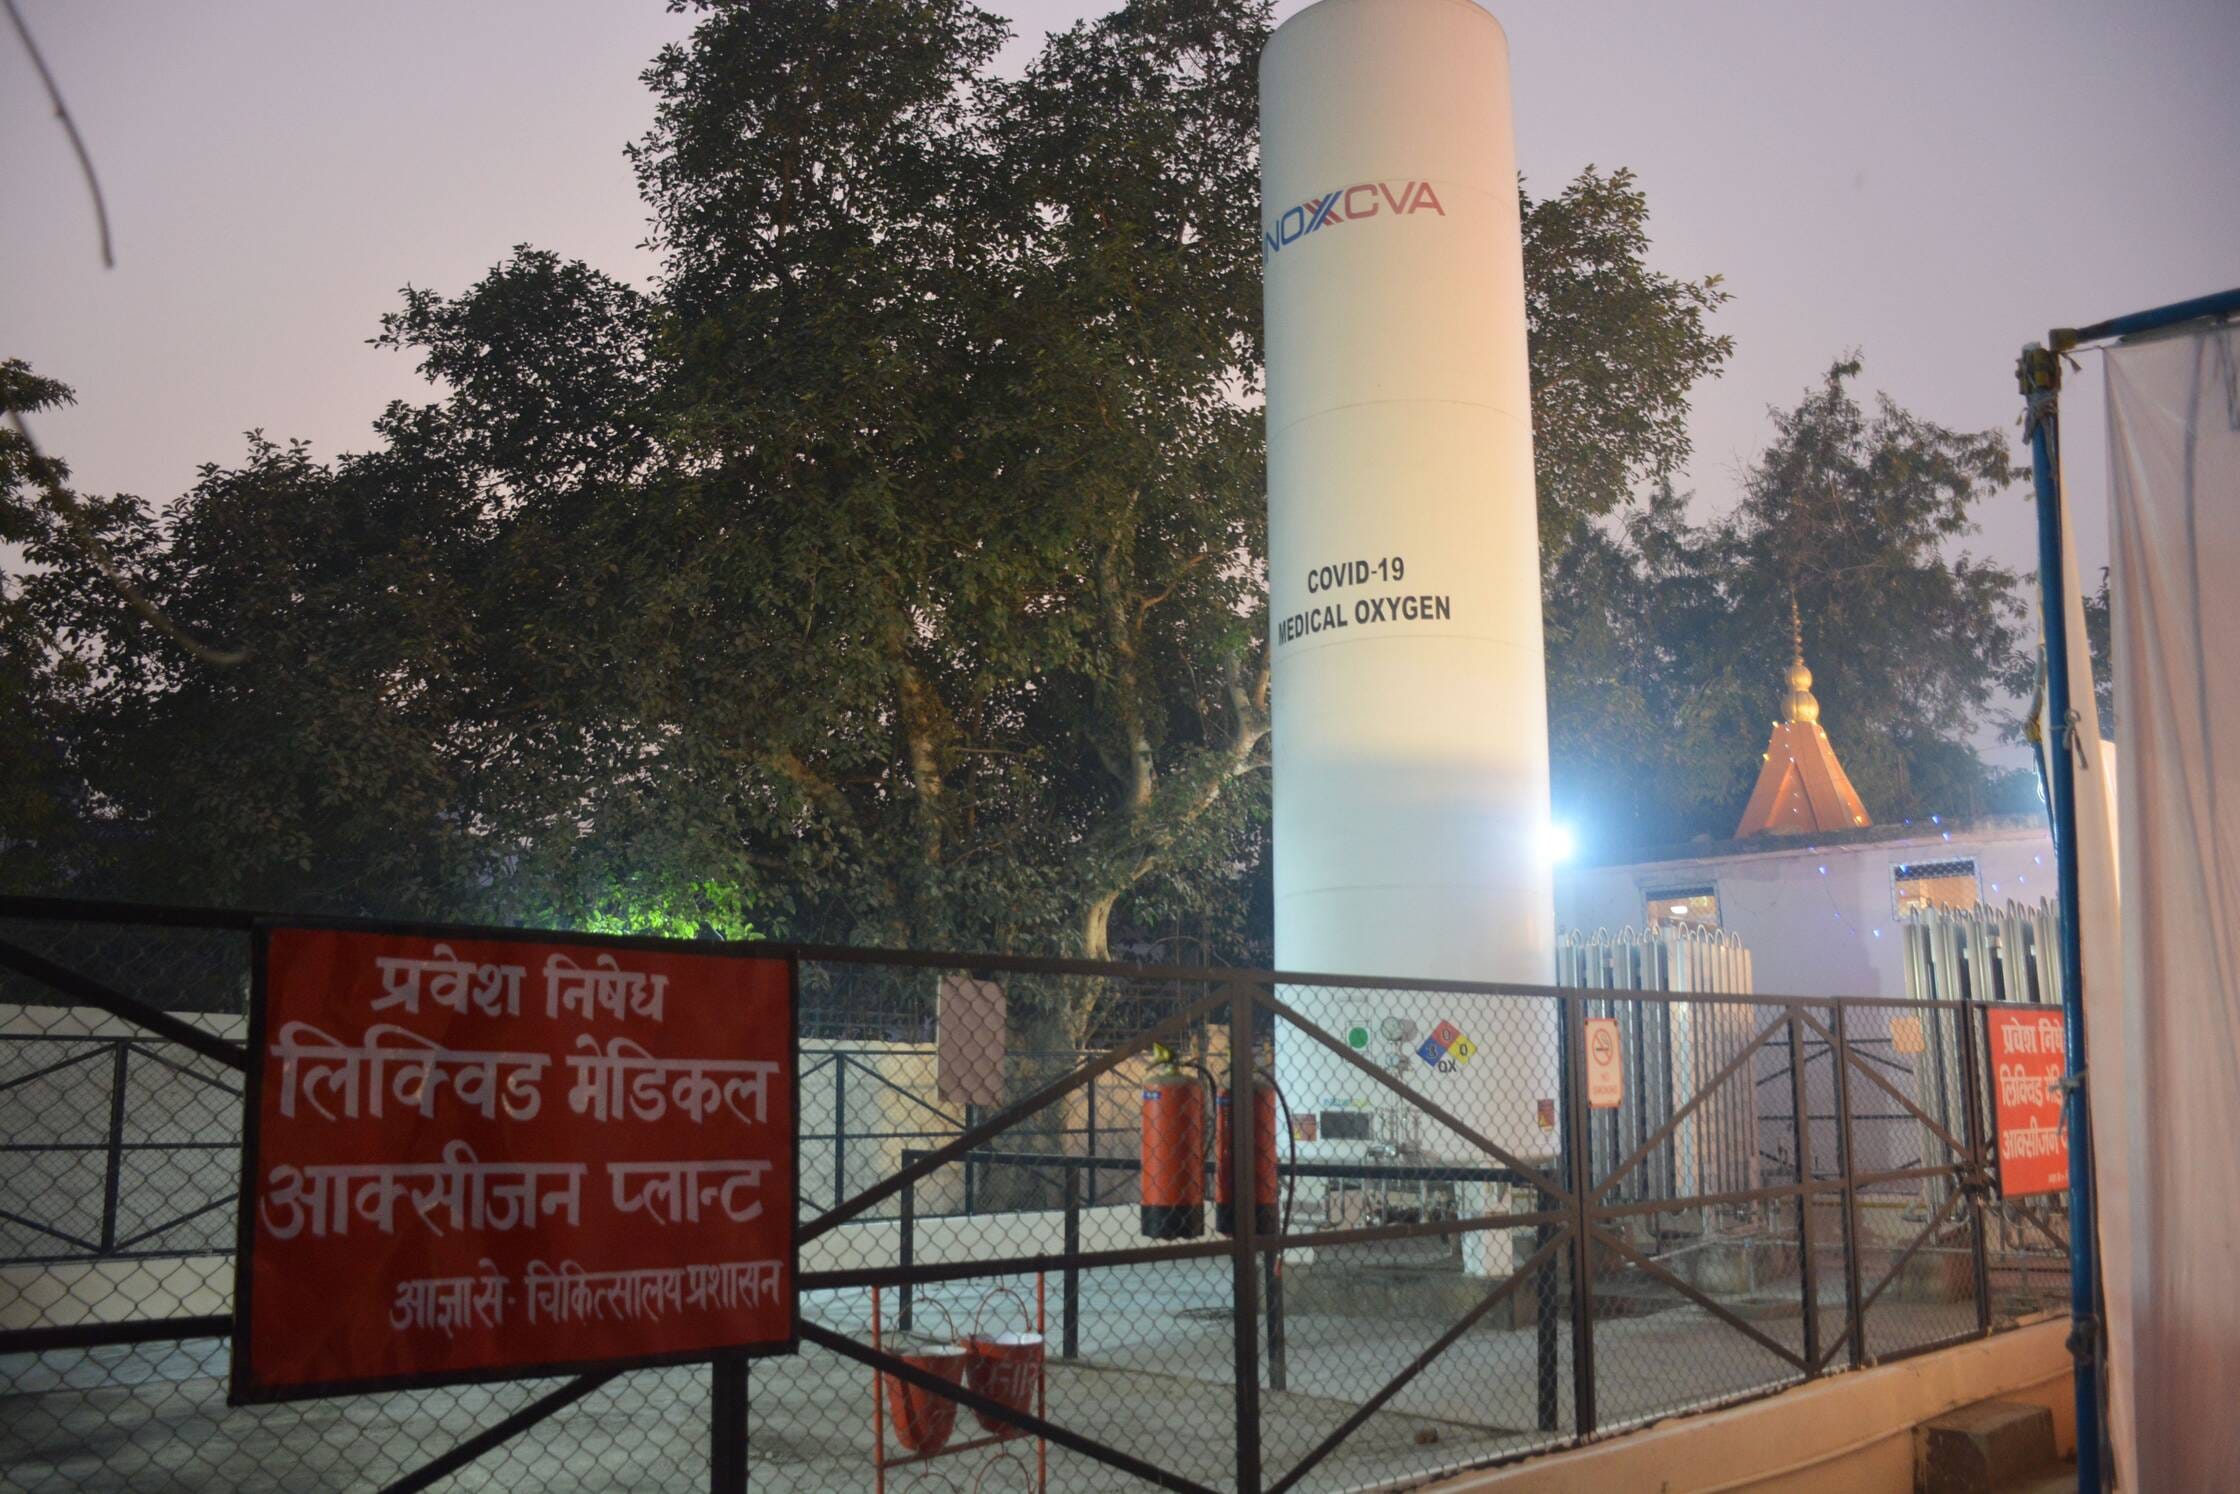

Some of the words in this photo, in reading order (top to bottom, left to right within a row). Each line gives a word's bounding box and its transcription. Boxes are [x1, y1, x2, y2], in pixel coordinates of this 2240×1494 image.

[1264, 181, 1445, 264] NOXCVA
[1308, 557, 1404, 593] COVID-19
[1278, 604, 1348, 646] MEDICAL
[1354, 595, 1450, 624] OXYGEN
[371, 943, 527, 1018] प्रवेश
[542, 953, 669, 1022] निषेध
[2000, 1017, 2037, 1054] प्रवेश
[2038, 1018, 2065, 1054] निषे
[565, 1033, 780, 1125] मेडिकल
[261, 1140, 588, 1238] आक्सीजन
[606, 1160, 772, 1225] प्लान्ट
[686, 1260, 784, 1311] प्रशासन
